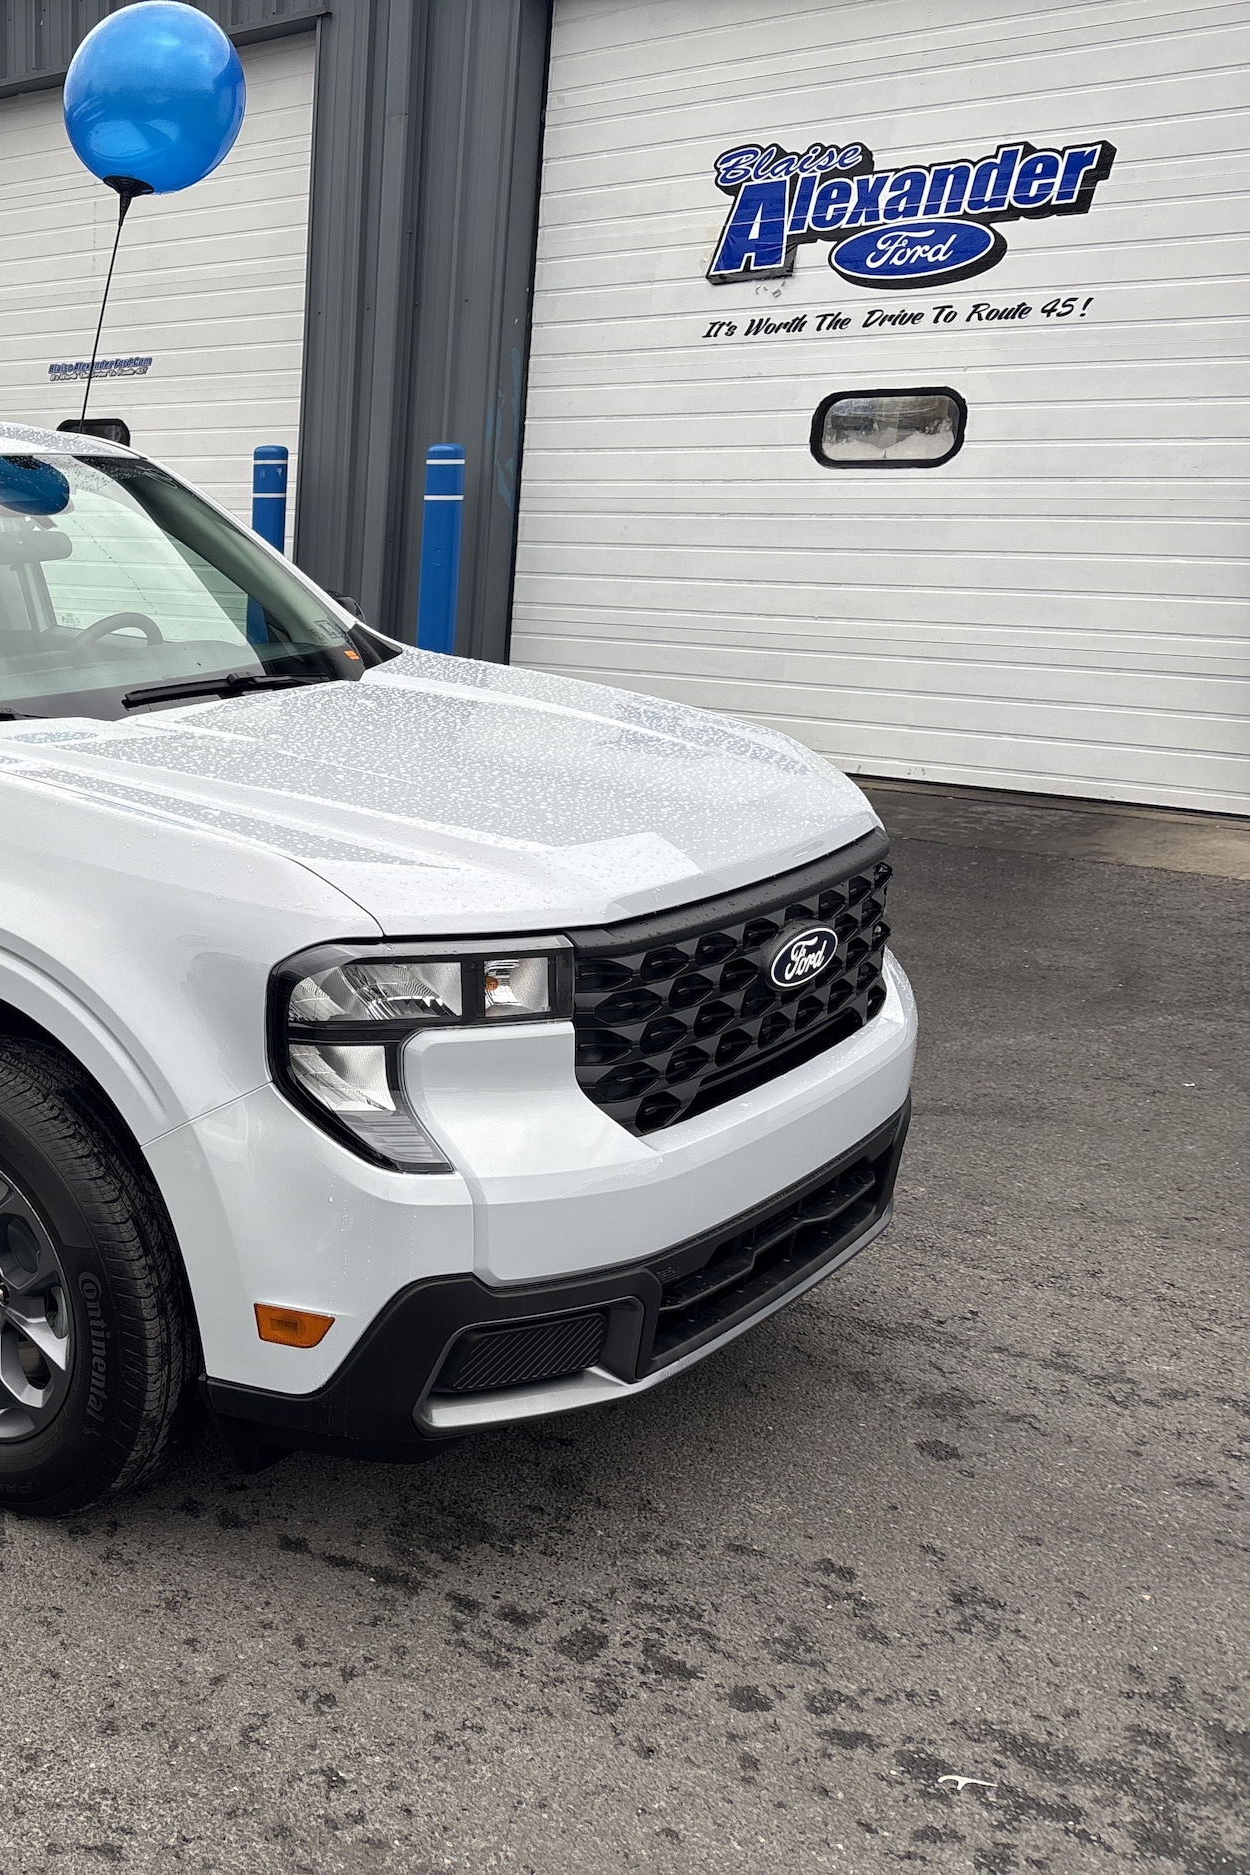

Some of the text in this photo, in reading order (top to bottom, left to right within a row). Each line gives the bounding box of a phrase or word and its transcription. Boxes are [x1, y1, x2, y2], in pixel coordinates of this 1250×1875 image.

[716, 144, 864, 187] Blaise
[709, 143, 1100, 275] Alexander
[865, 229, 953, 270] Ford
[702, 320, 738, 338] It's
[744, 314, 808, 336] Worth
[816, 312, 852, 331] The
[862, 309, 924, 328] Drive
[932, 304, 958, 324] To
[965, 302, 1033, 322] Route
[784, 935, 828, 981] Ford
[78, 1271, 111, 1423] Continental
